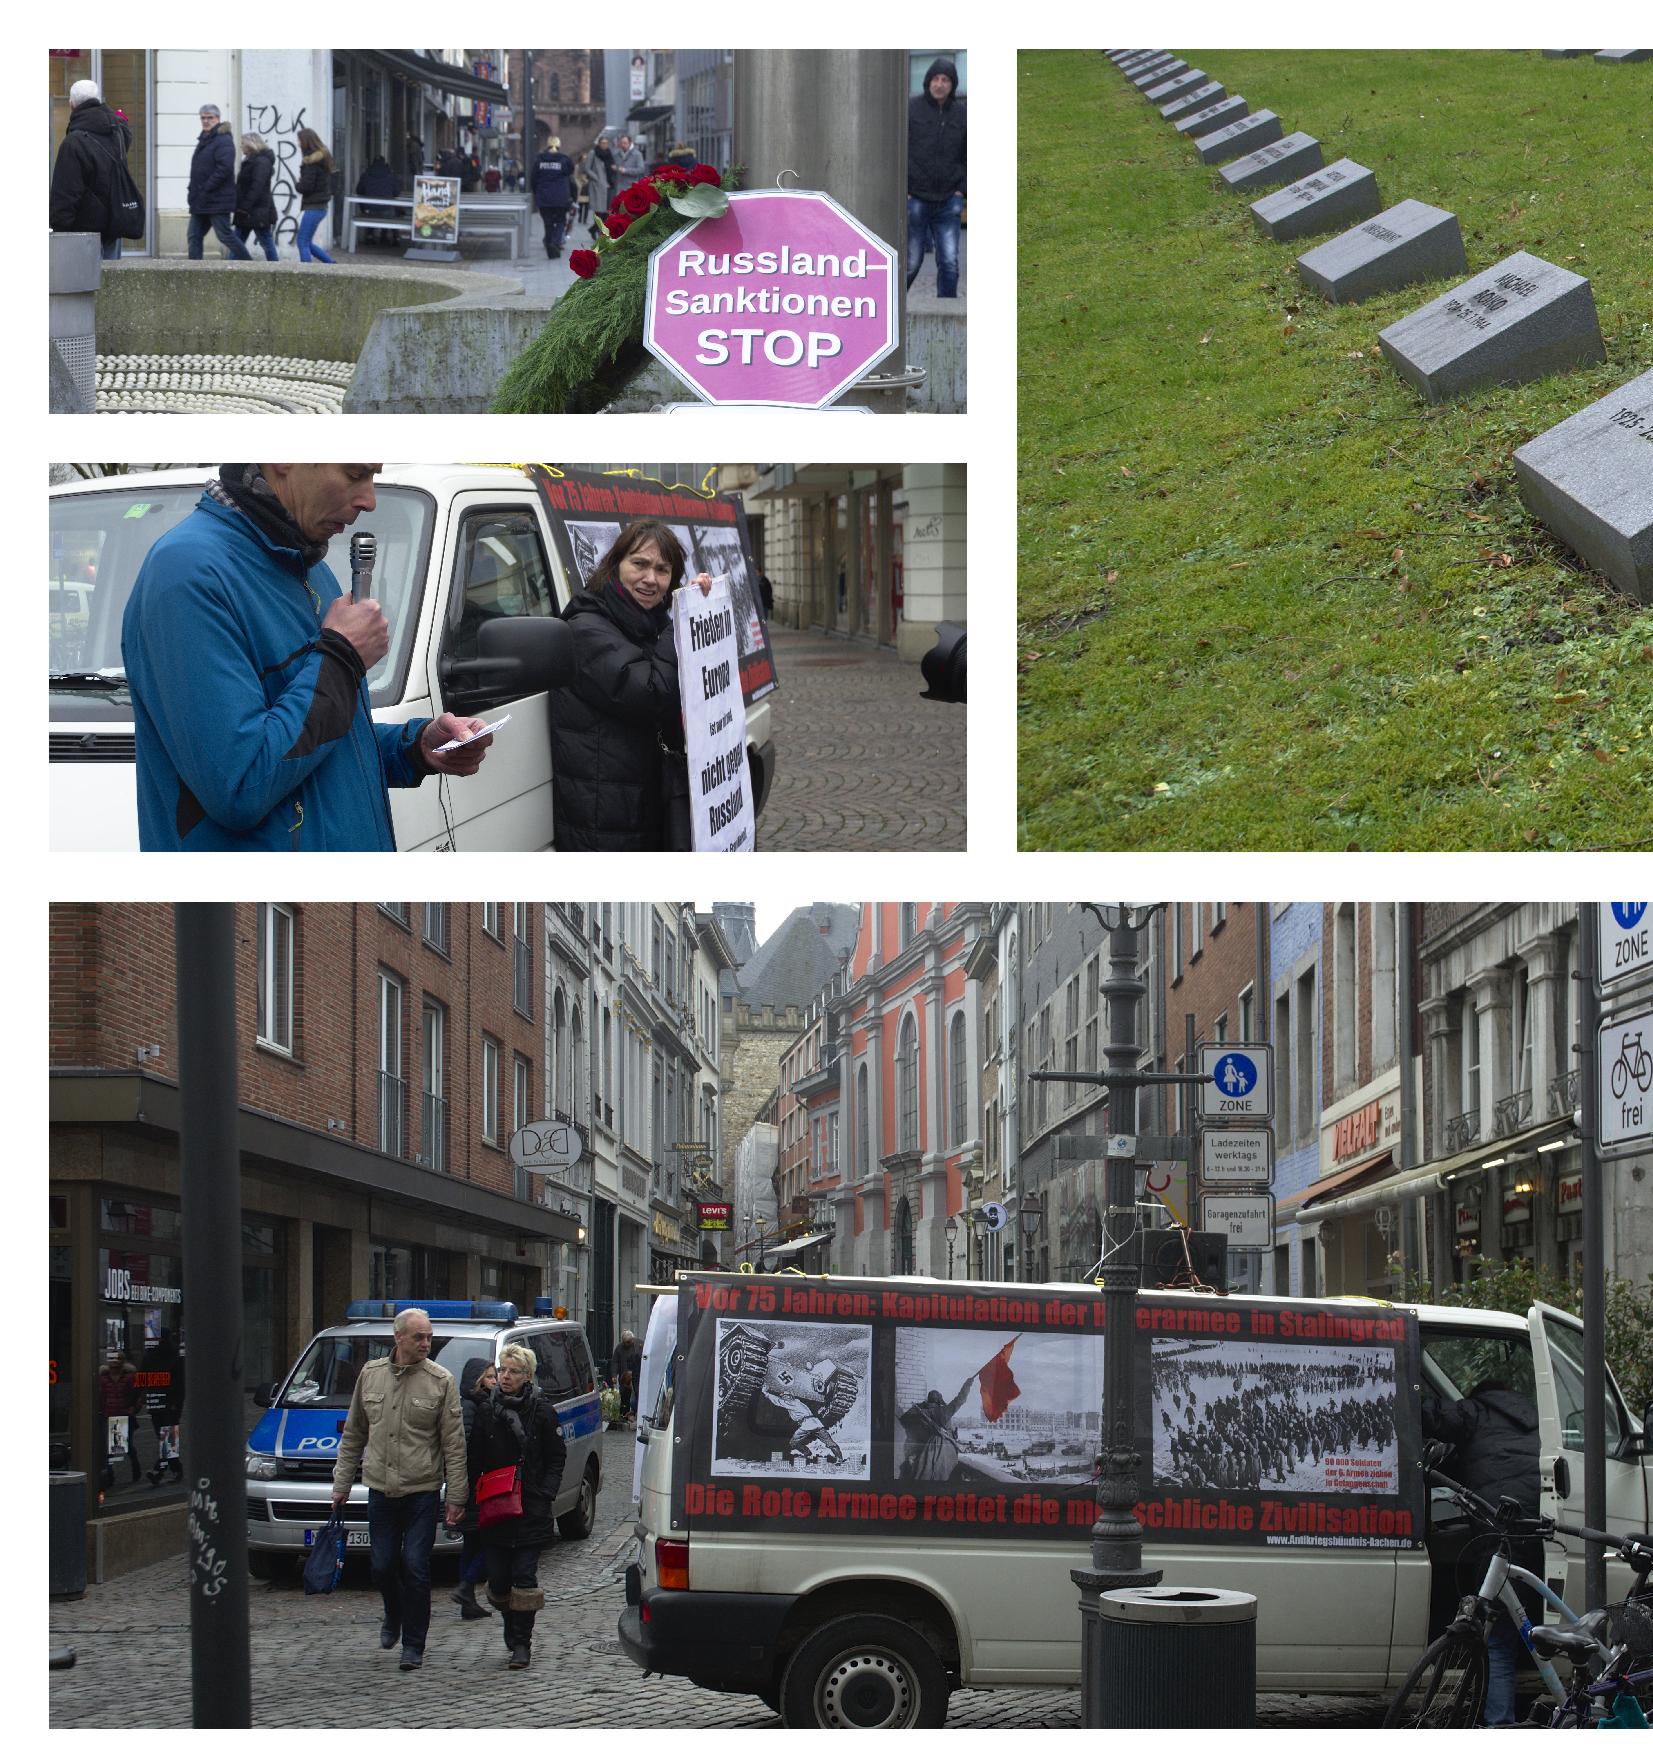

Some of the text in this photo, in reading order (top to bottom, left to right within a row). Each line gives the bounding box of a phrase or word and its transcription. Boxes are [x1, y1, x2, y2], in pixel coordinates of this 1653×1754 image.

[665, 286, 877, 318] Sanktionen
[695, 329, 842, 378] STOP
[689, 612, 724, 652] Frieden
[702, 659, 730, 701] Europa
[709, 780, 743, 837] Russland
[1615, 930, 1649, 968] ZONE
[1219, 1100, 1253, 1112] ZONE
[1621, 1097, 1644, 1130] frei
[1211, 1138, 1261, 1148] Ladezeiten
[1214, 1150, 1258, 1161] werktags
[1207, 1209, 1266, 1220] Garagenzufahrt
[1229, 1222, 1243, 1234] frei
[105, 1268, 131, 1300] JOBS
[693, 1284, 739, 1311] Vor
[749, 1285, 776, 1312] 75
[781, 1287, 877, 1317] Jahren:
[882, 1292, 1038, 1324] Kapitulation
[1045, 1301, 1088, 1327] der
[1251, 1309, 1276, 1335] in
[1279, 1310, 1406, 1342] Stalingrad
[684, 1482, 735, 1516] Die
[742, 1484, 812, 1518] Rote
[817, 1486, 917, 1521] Armee
[922, 1493, 1008, 1524] rettet
[1013, 1493, 1060, 1524] die
[1259, 1501, 1413, 1537] Zivilisation
